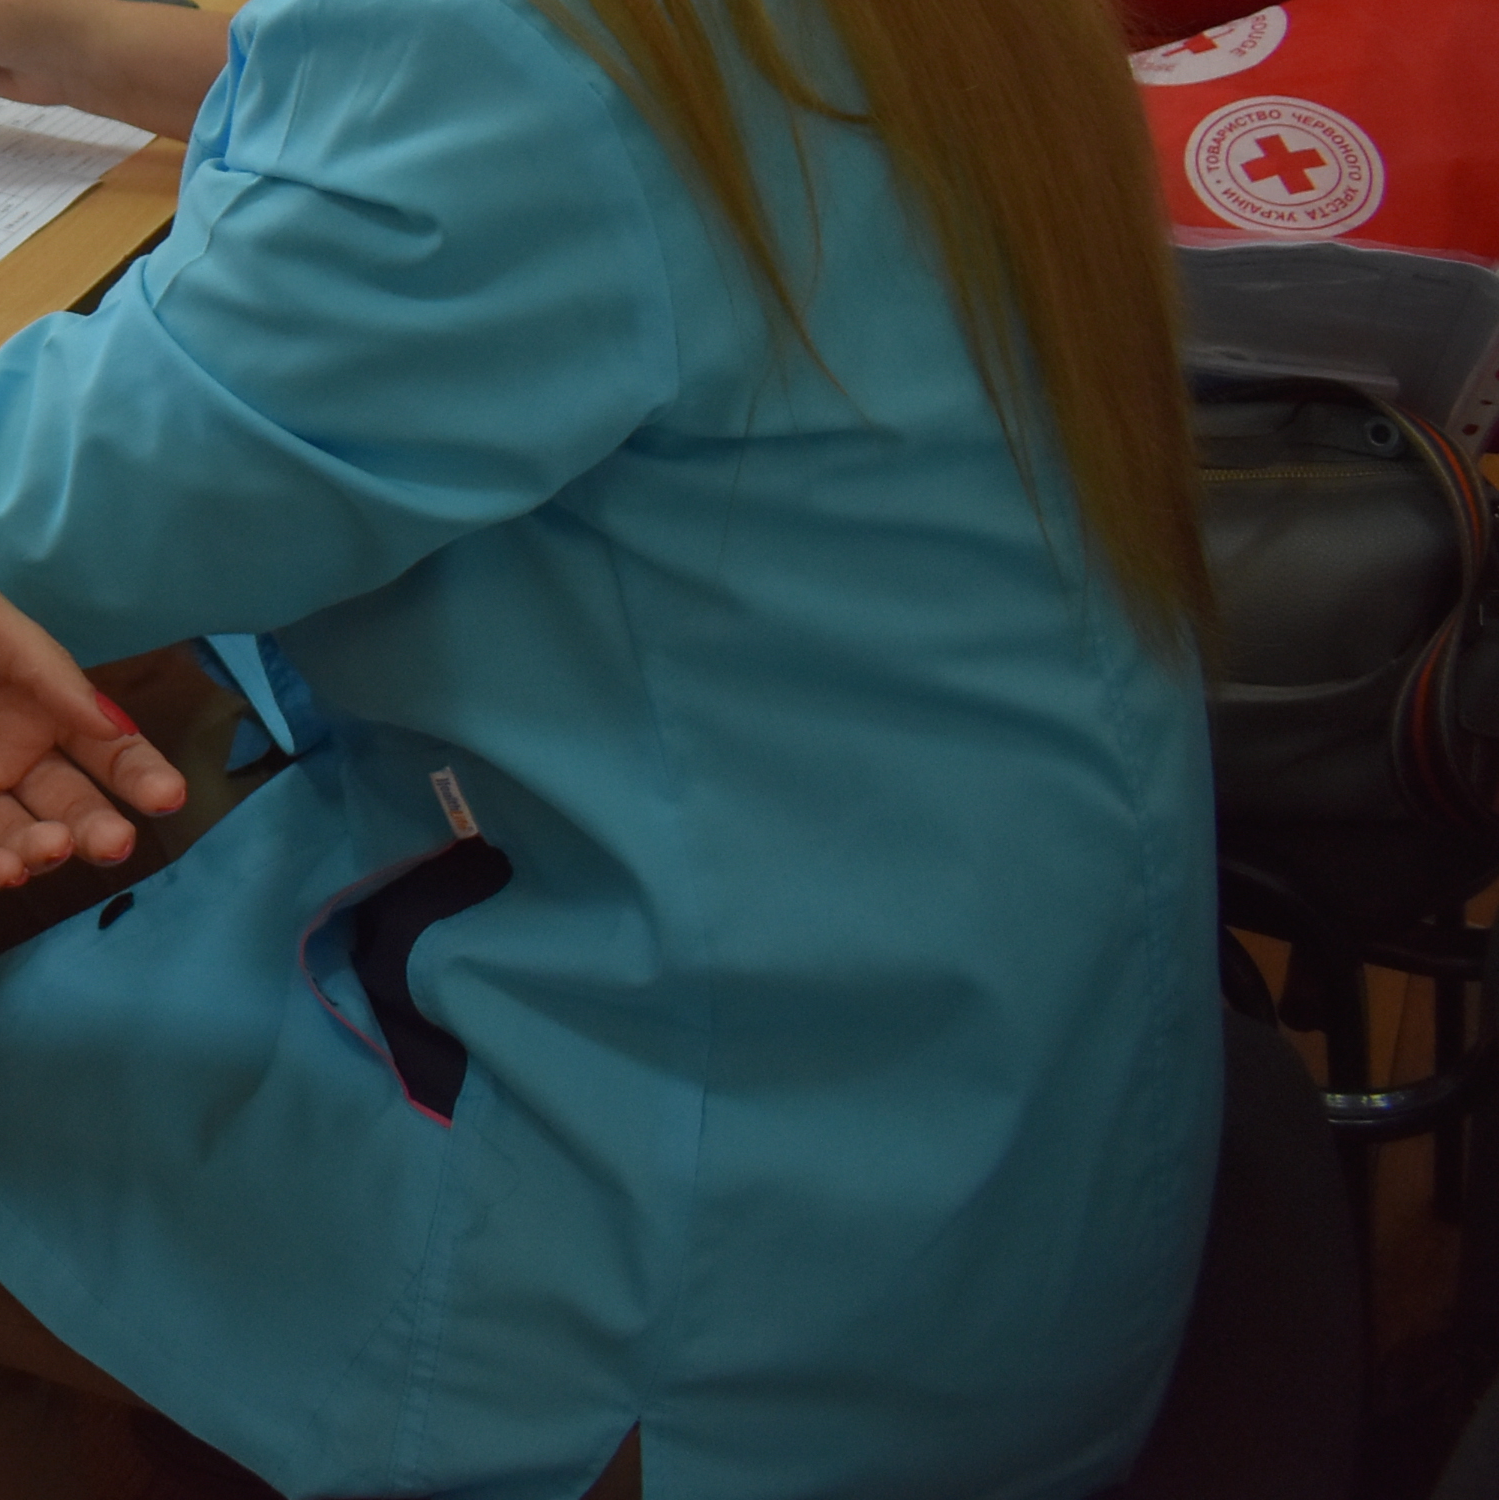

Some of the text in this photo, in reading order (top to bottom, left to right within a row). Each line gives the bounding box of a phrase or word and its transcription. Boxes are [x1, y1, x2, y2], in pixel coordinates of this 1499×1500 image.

[1206, 108, 1363, 223] ТОВАРИСТВО ЧЕРВОНОГО ХРЕСТА УКРАЇНИ
